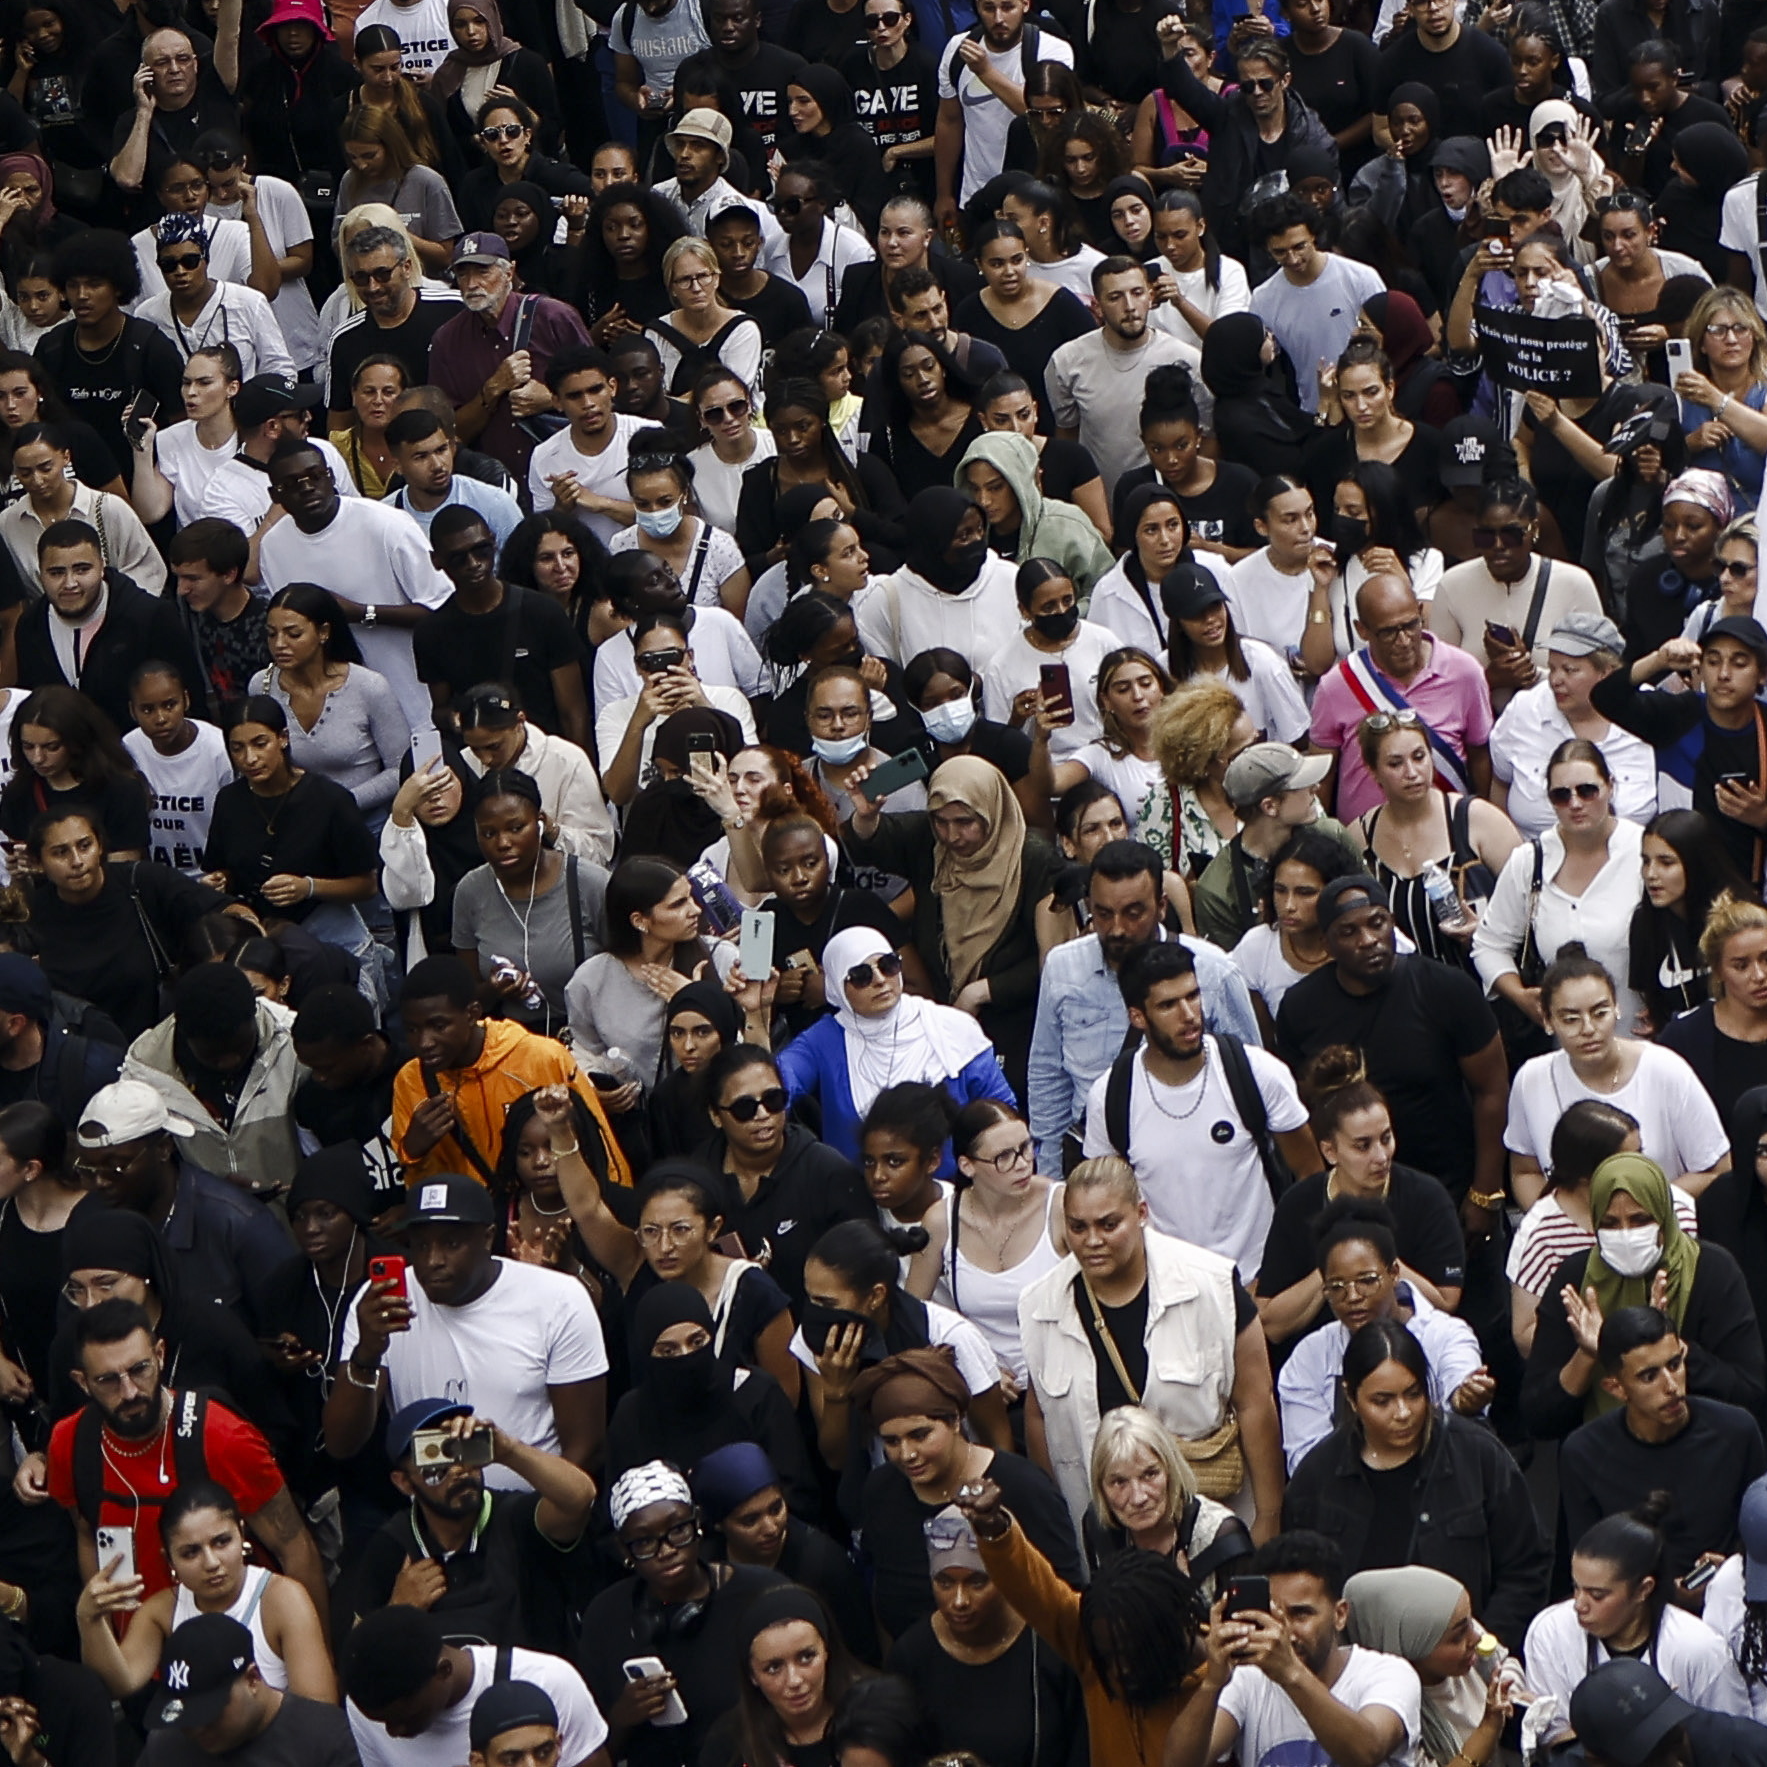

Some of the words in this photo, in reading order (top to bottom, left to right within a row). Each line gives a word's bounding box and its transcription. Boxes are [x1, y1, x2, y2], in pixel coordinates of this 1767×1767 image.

[856, 84, 919, 116] GAYE
[1502, 333, 1518, 344] qui
[1520, 335, 1544, 348] nous
[1518, 350, 1530, 361] de
[1531, 351, 1542, 363] la
[1507, 362, 1560, 382] POLICE
[1563, 370, 1572, 382] ?
[168, 1659, 190, 1690] NY
